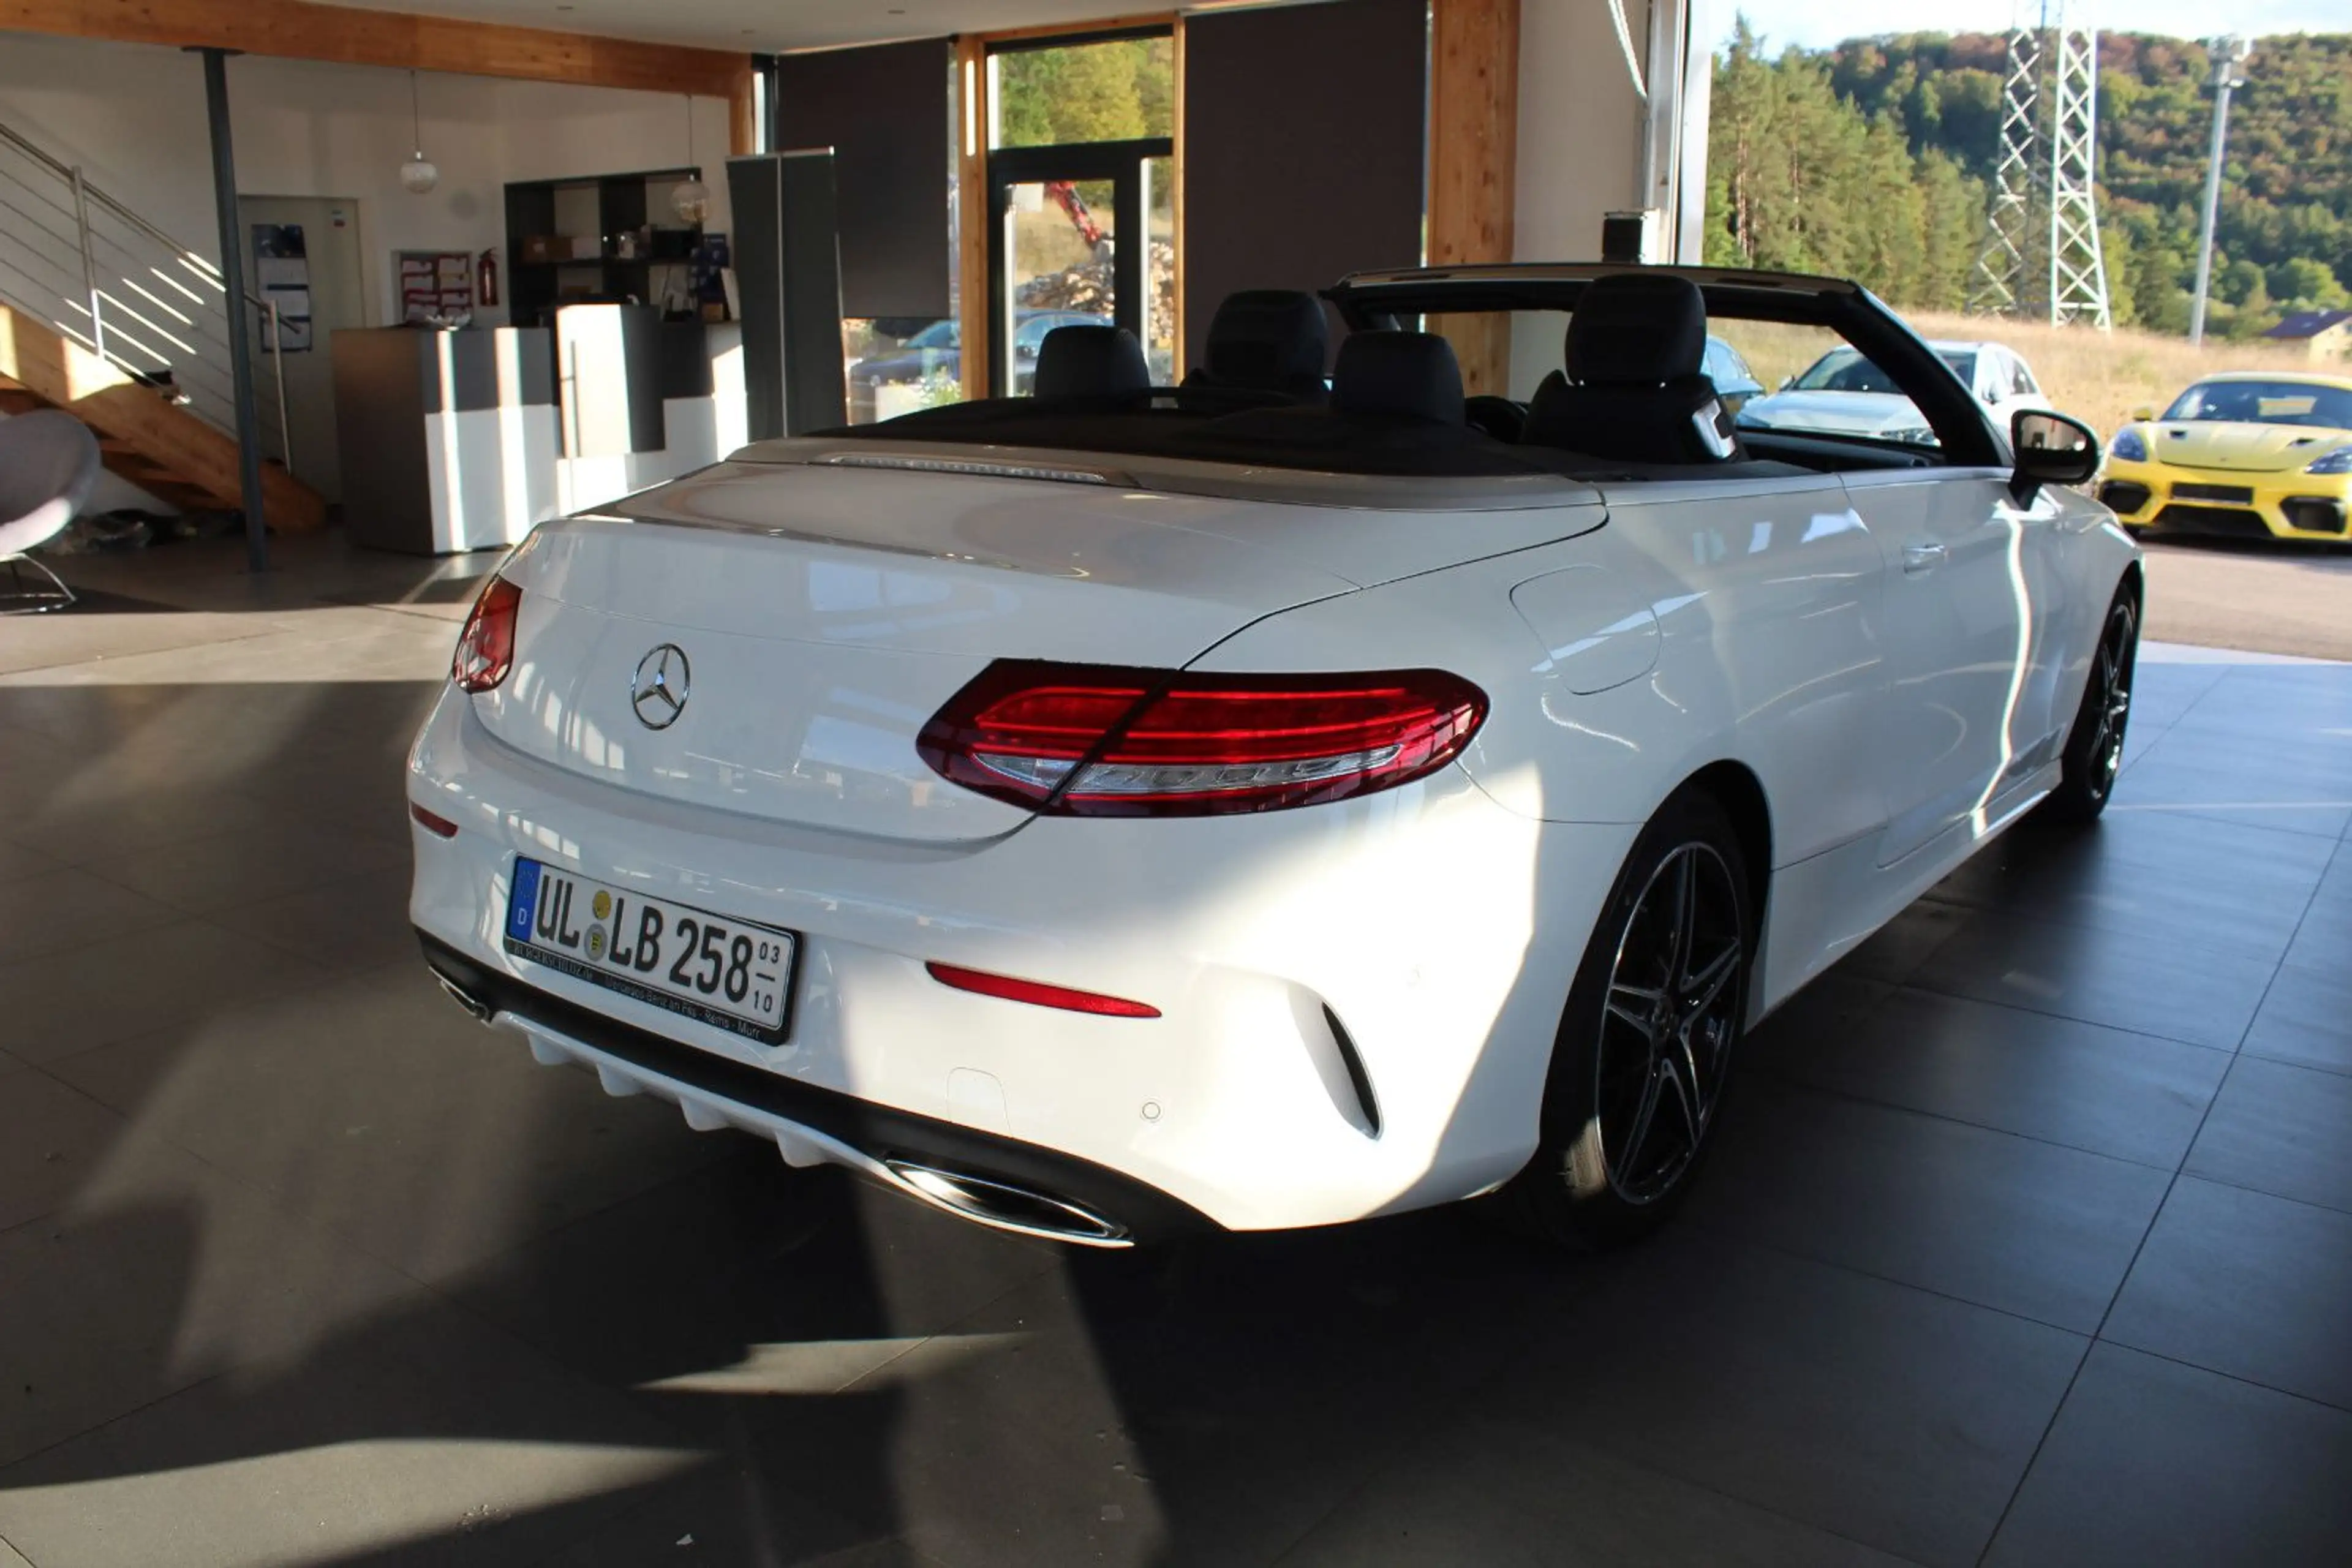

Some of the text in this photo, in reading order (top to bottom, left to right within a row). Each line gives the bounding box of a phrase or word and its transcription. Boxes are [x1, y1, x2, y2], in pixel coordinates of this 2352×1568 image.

[517, 907, 527, 926] D
[537, 874, 580, 949] UL
[609, 897, 663, 972] LB
[669, 918, 753, 1003] 258
[760, 941, 780, 965] 03
[754, 989, 773, 1014] 10
